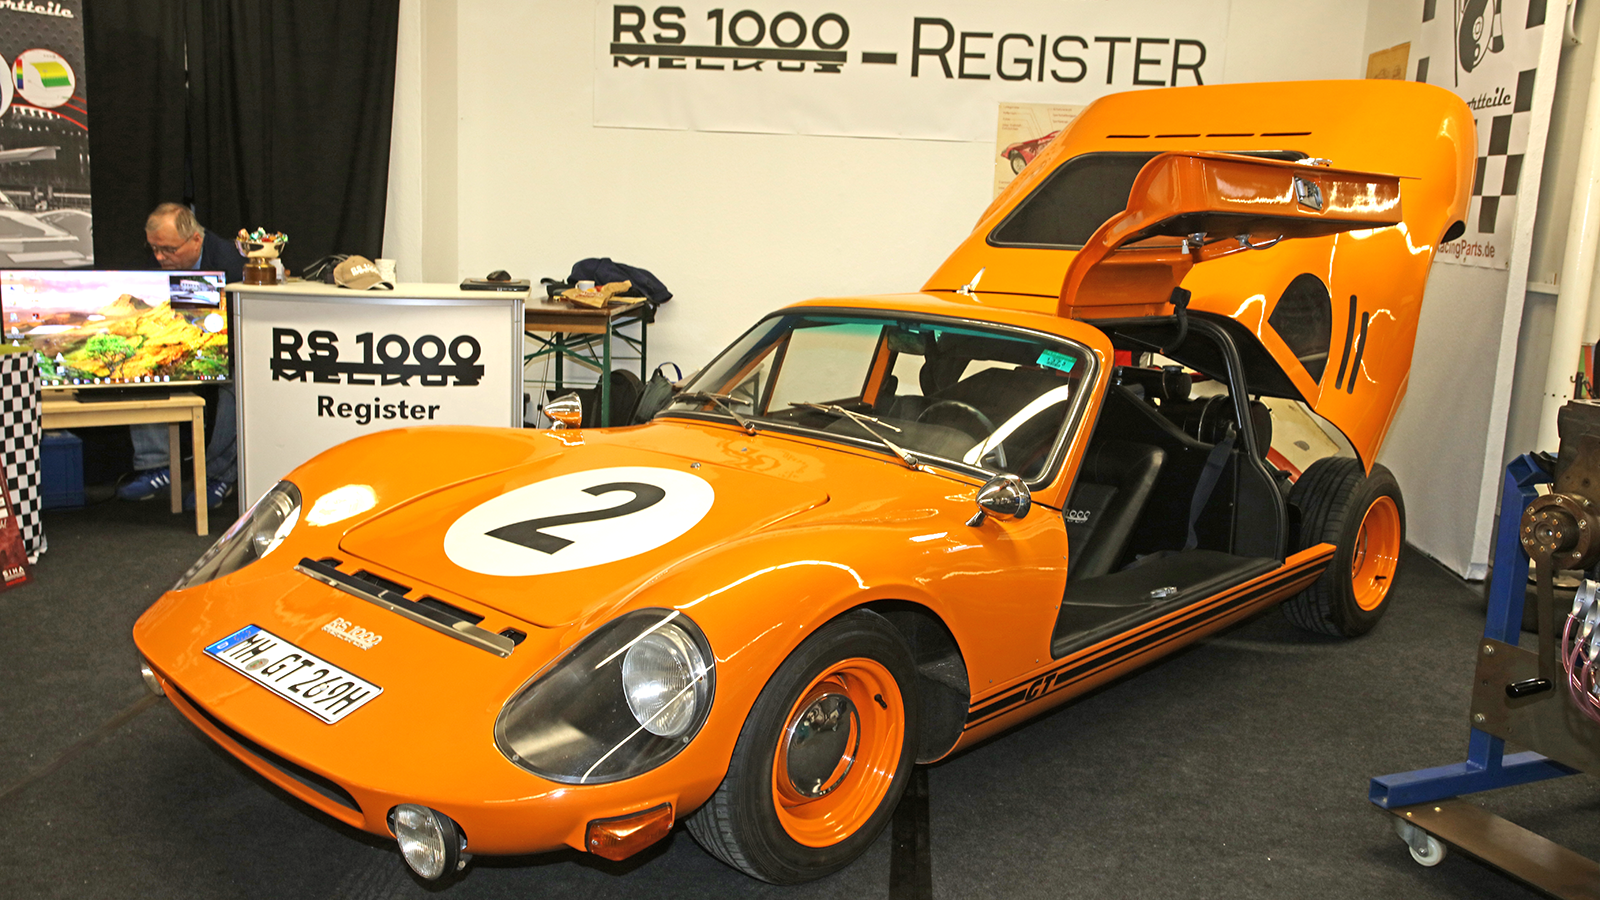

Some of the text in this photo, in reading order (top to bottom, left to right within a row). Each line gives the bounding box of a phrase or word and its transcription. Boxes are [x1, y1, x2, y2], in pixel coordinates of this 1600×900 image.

[613, 5, 686, 44] RS
[707, 9, 850, 50] 1000
[272, 327, 482, 366] RS 1000
[317, 395, 441, 425] Register
[484, 481, 666, 555] 2
[325, 617, 352, 633] RS
[347, 625, 383, 647] 1000
[1024, 672, 1058, 702] GT
